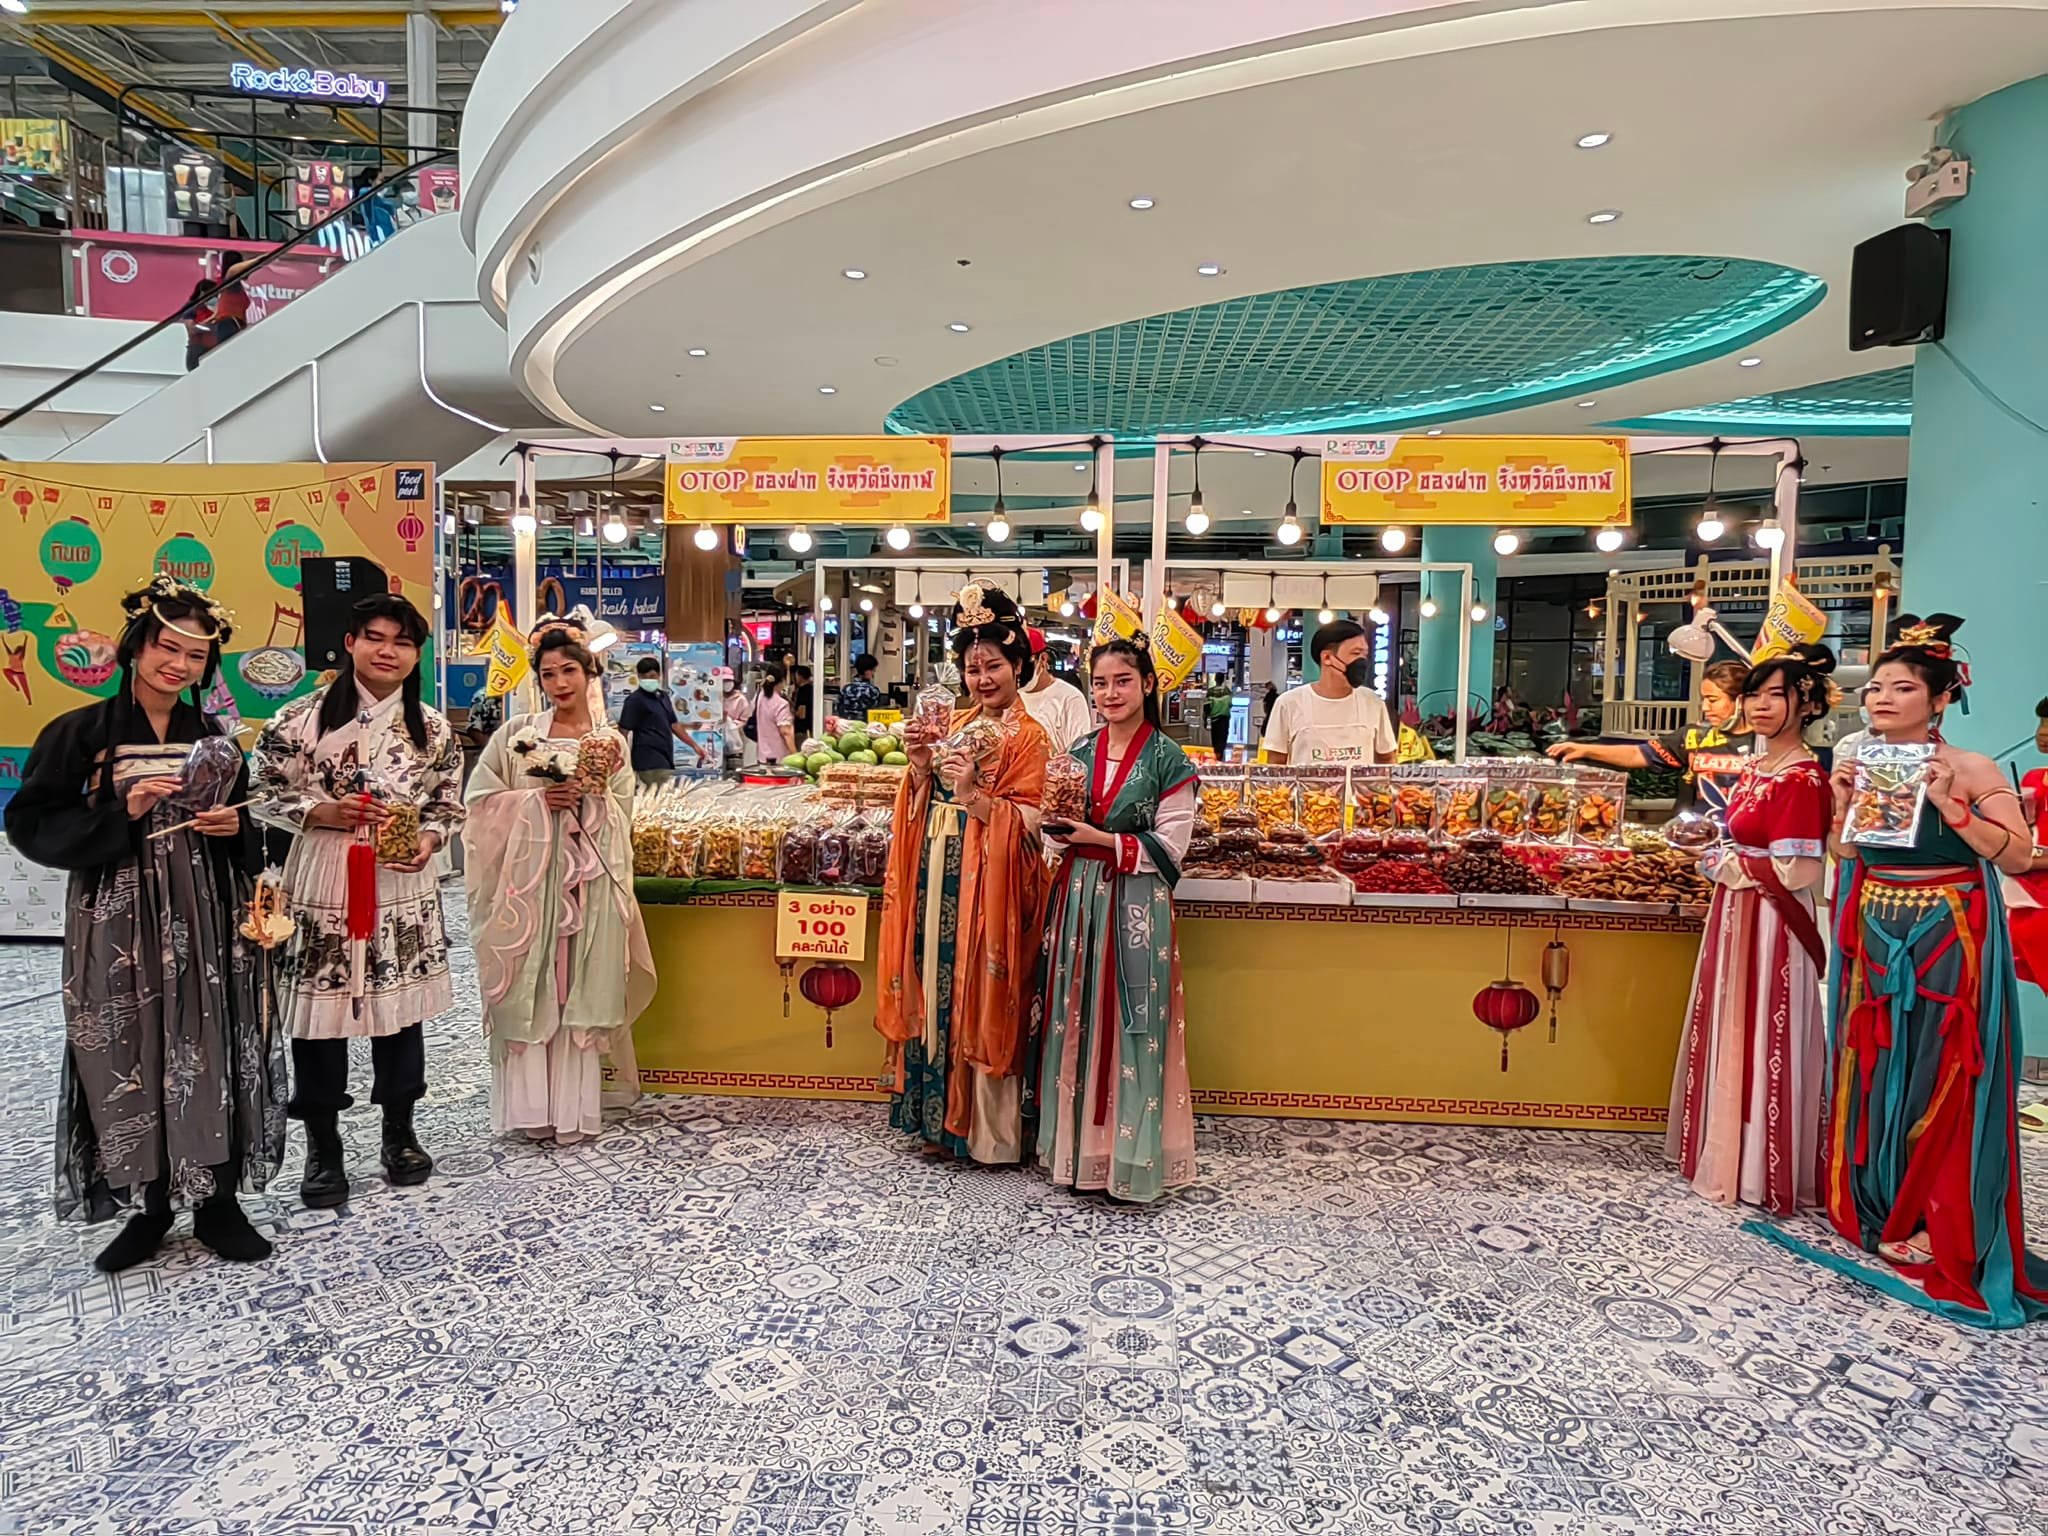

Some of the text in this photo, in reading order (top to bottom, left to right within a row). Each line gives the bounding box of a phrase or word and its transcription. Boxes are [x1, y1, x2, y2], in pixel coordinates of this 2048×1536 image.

[231, 63, 385, 103] Rock&Baby
[400, 471, 423, 485] Food
[680, 467, 935, 491] OTOP ของฝาก จังหวัดบึงกาฬ
[1337, 467, 1615, 492] OTOP ของฝาก จังหวัดบึงกาฬ
[51, 541, 92, 562] กินเจ
[788, 899, 857, 916] 3 อย่าง
[797, 919, 846, 937] 100
[791, 939, 850, 955] คละกันได้
